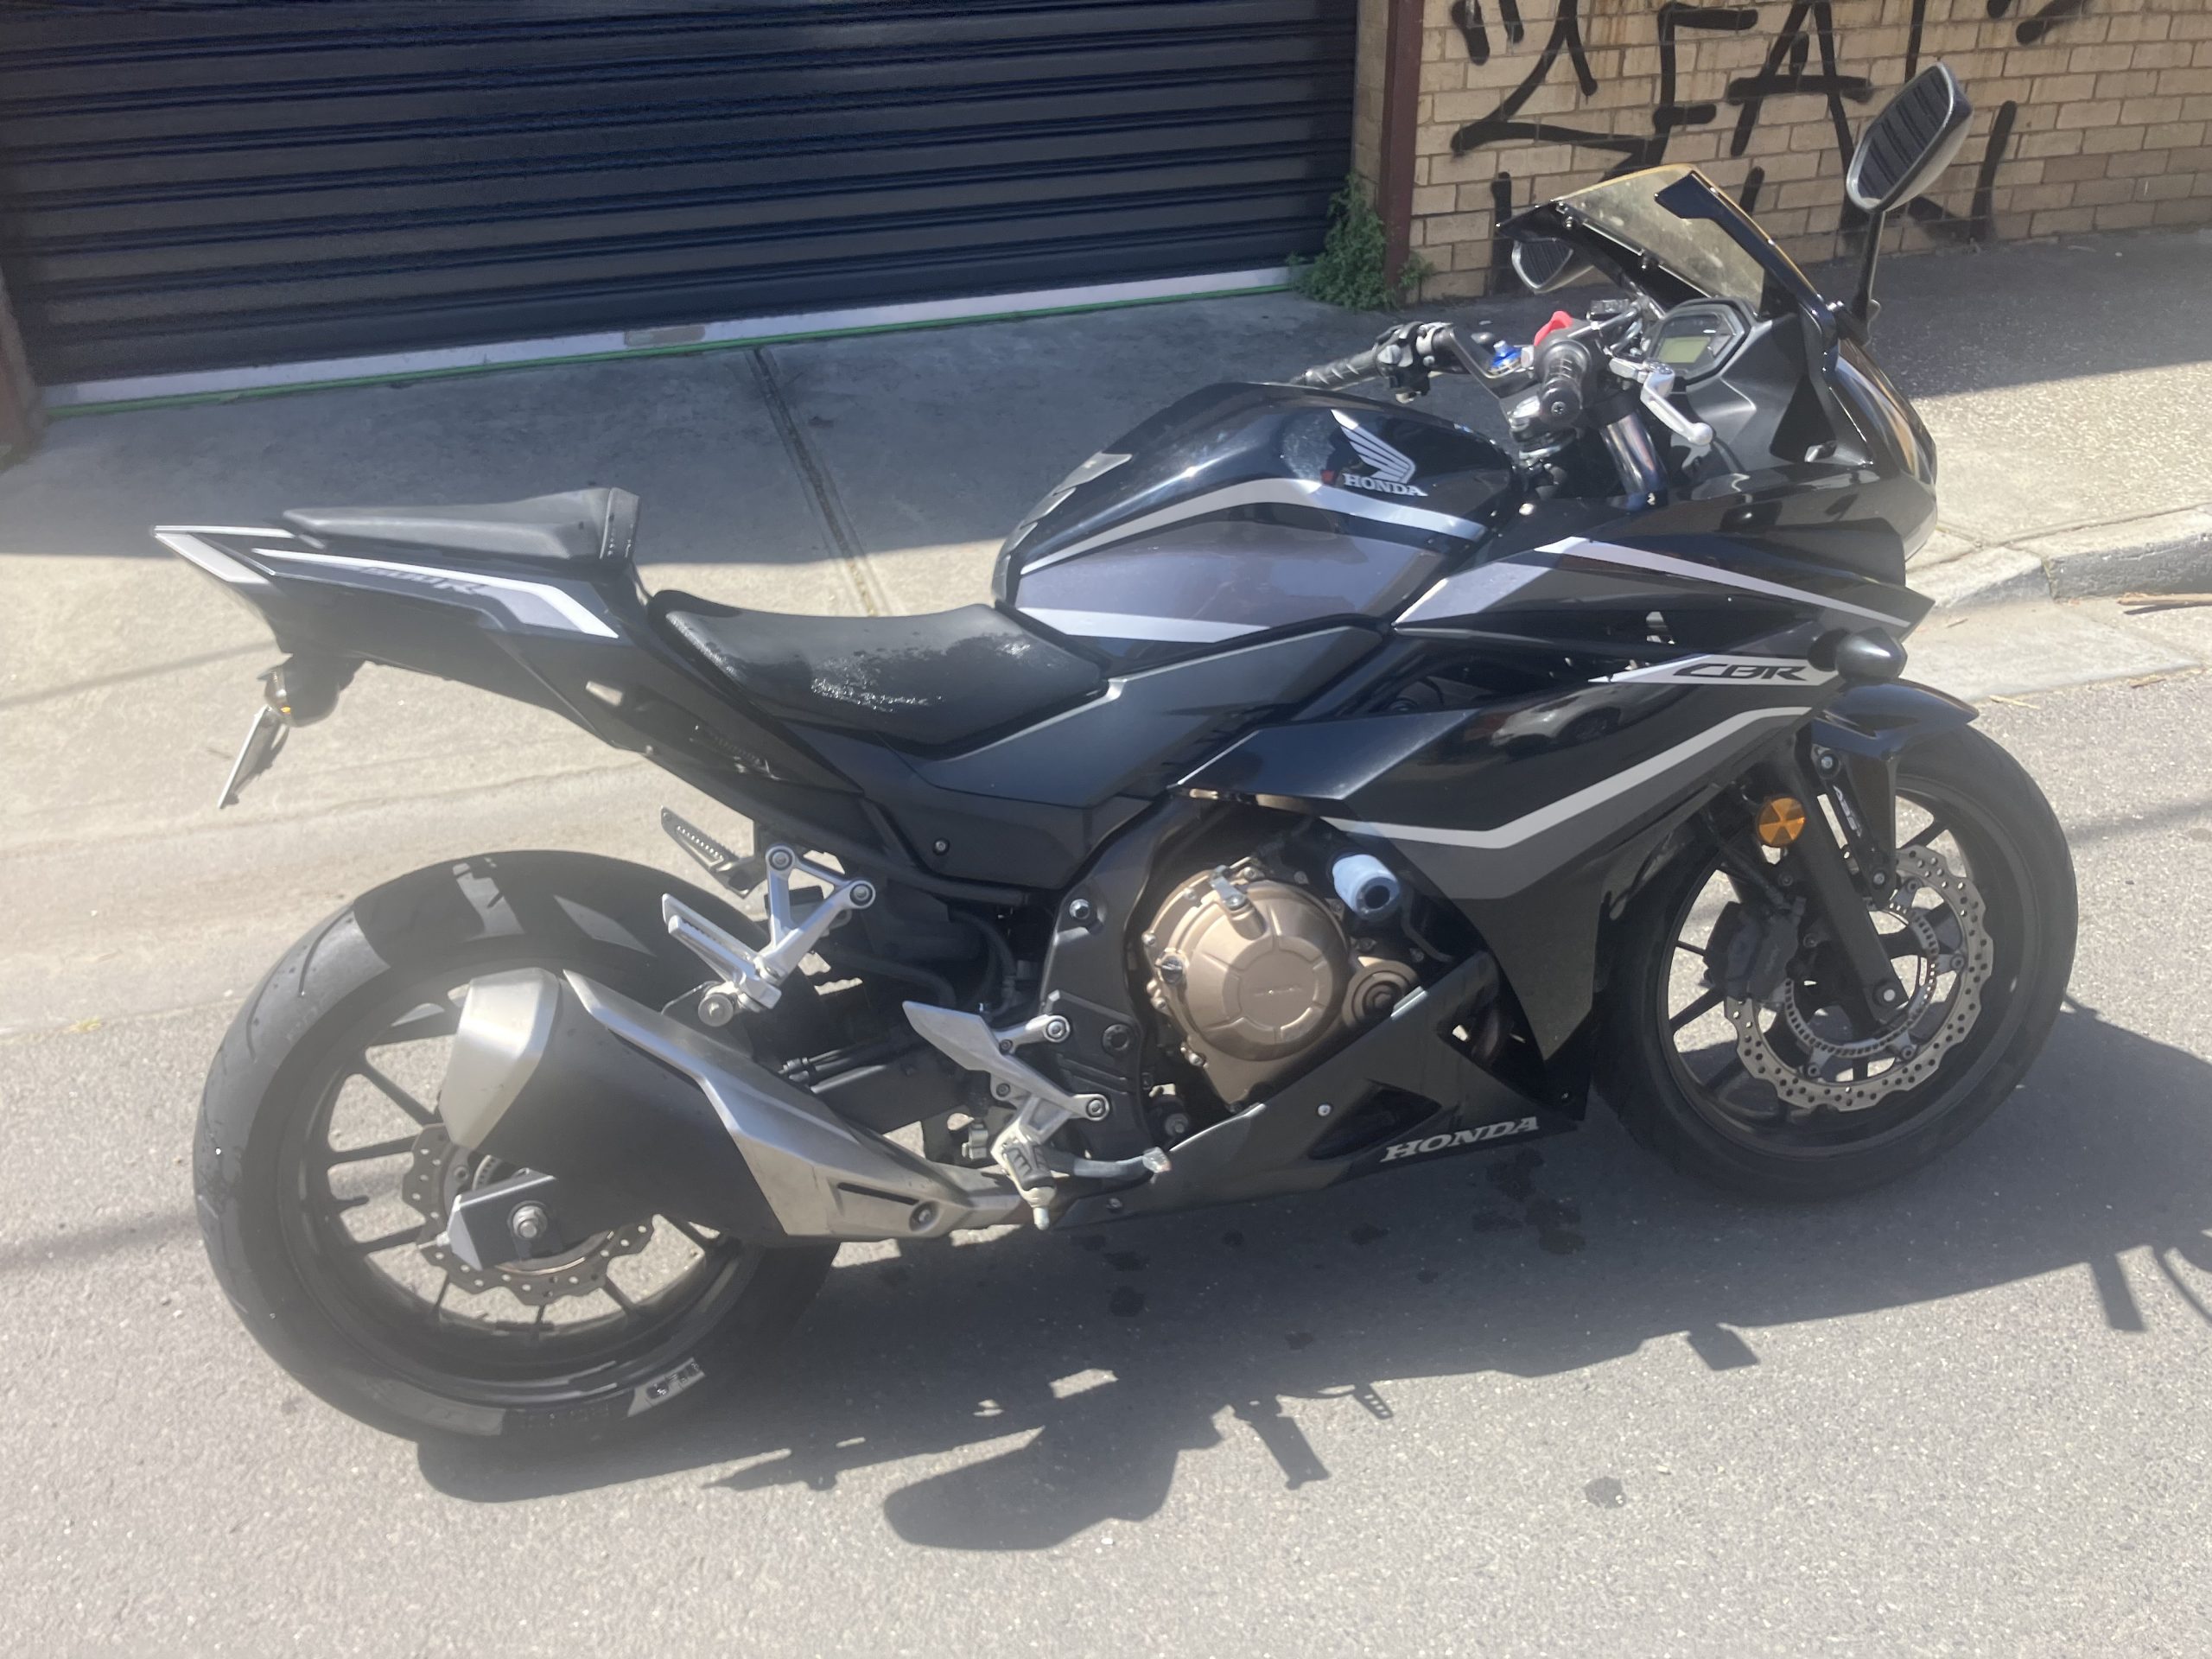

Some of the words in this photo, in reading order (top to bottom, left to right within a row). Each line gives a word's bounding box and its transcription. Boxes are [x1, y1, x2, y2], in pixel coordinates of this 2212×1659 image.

[1342, 473, 1428, 497] HONDA
[1673, 663, 1808, 682] CBR
[1380, 1116, 1539, 1162] HONDA
